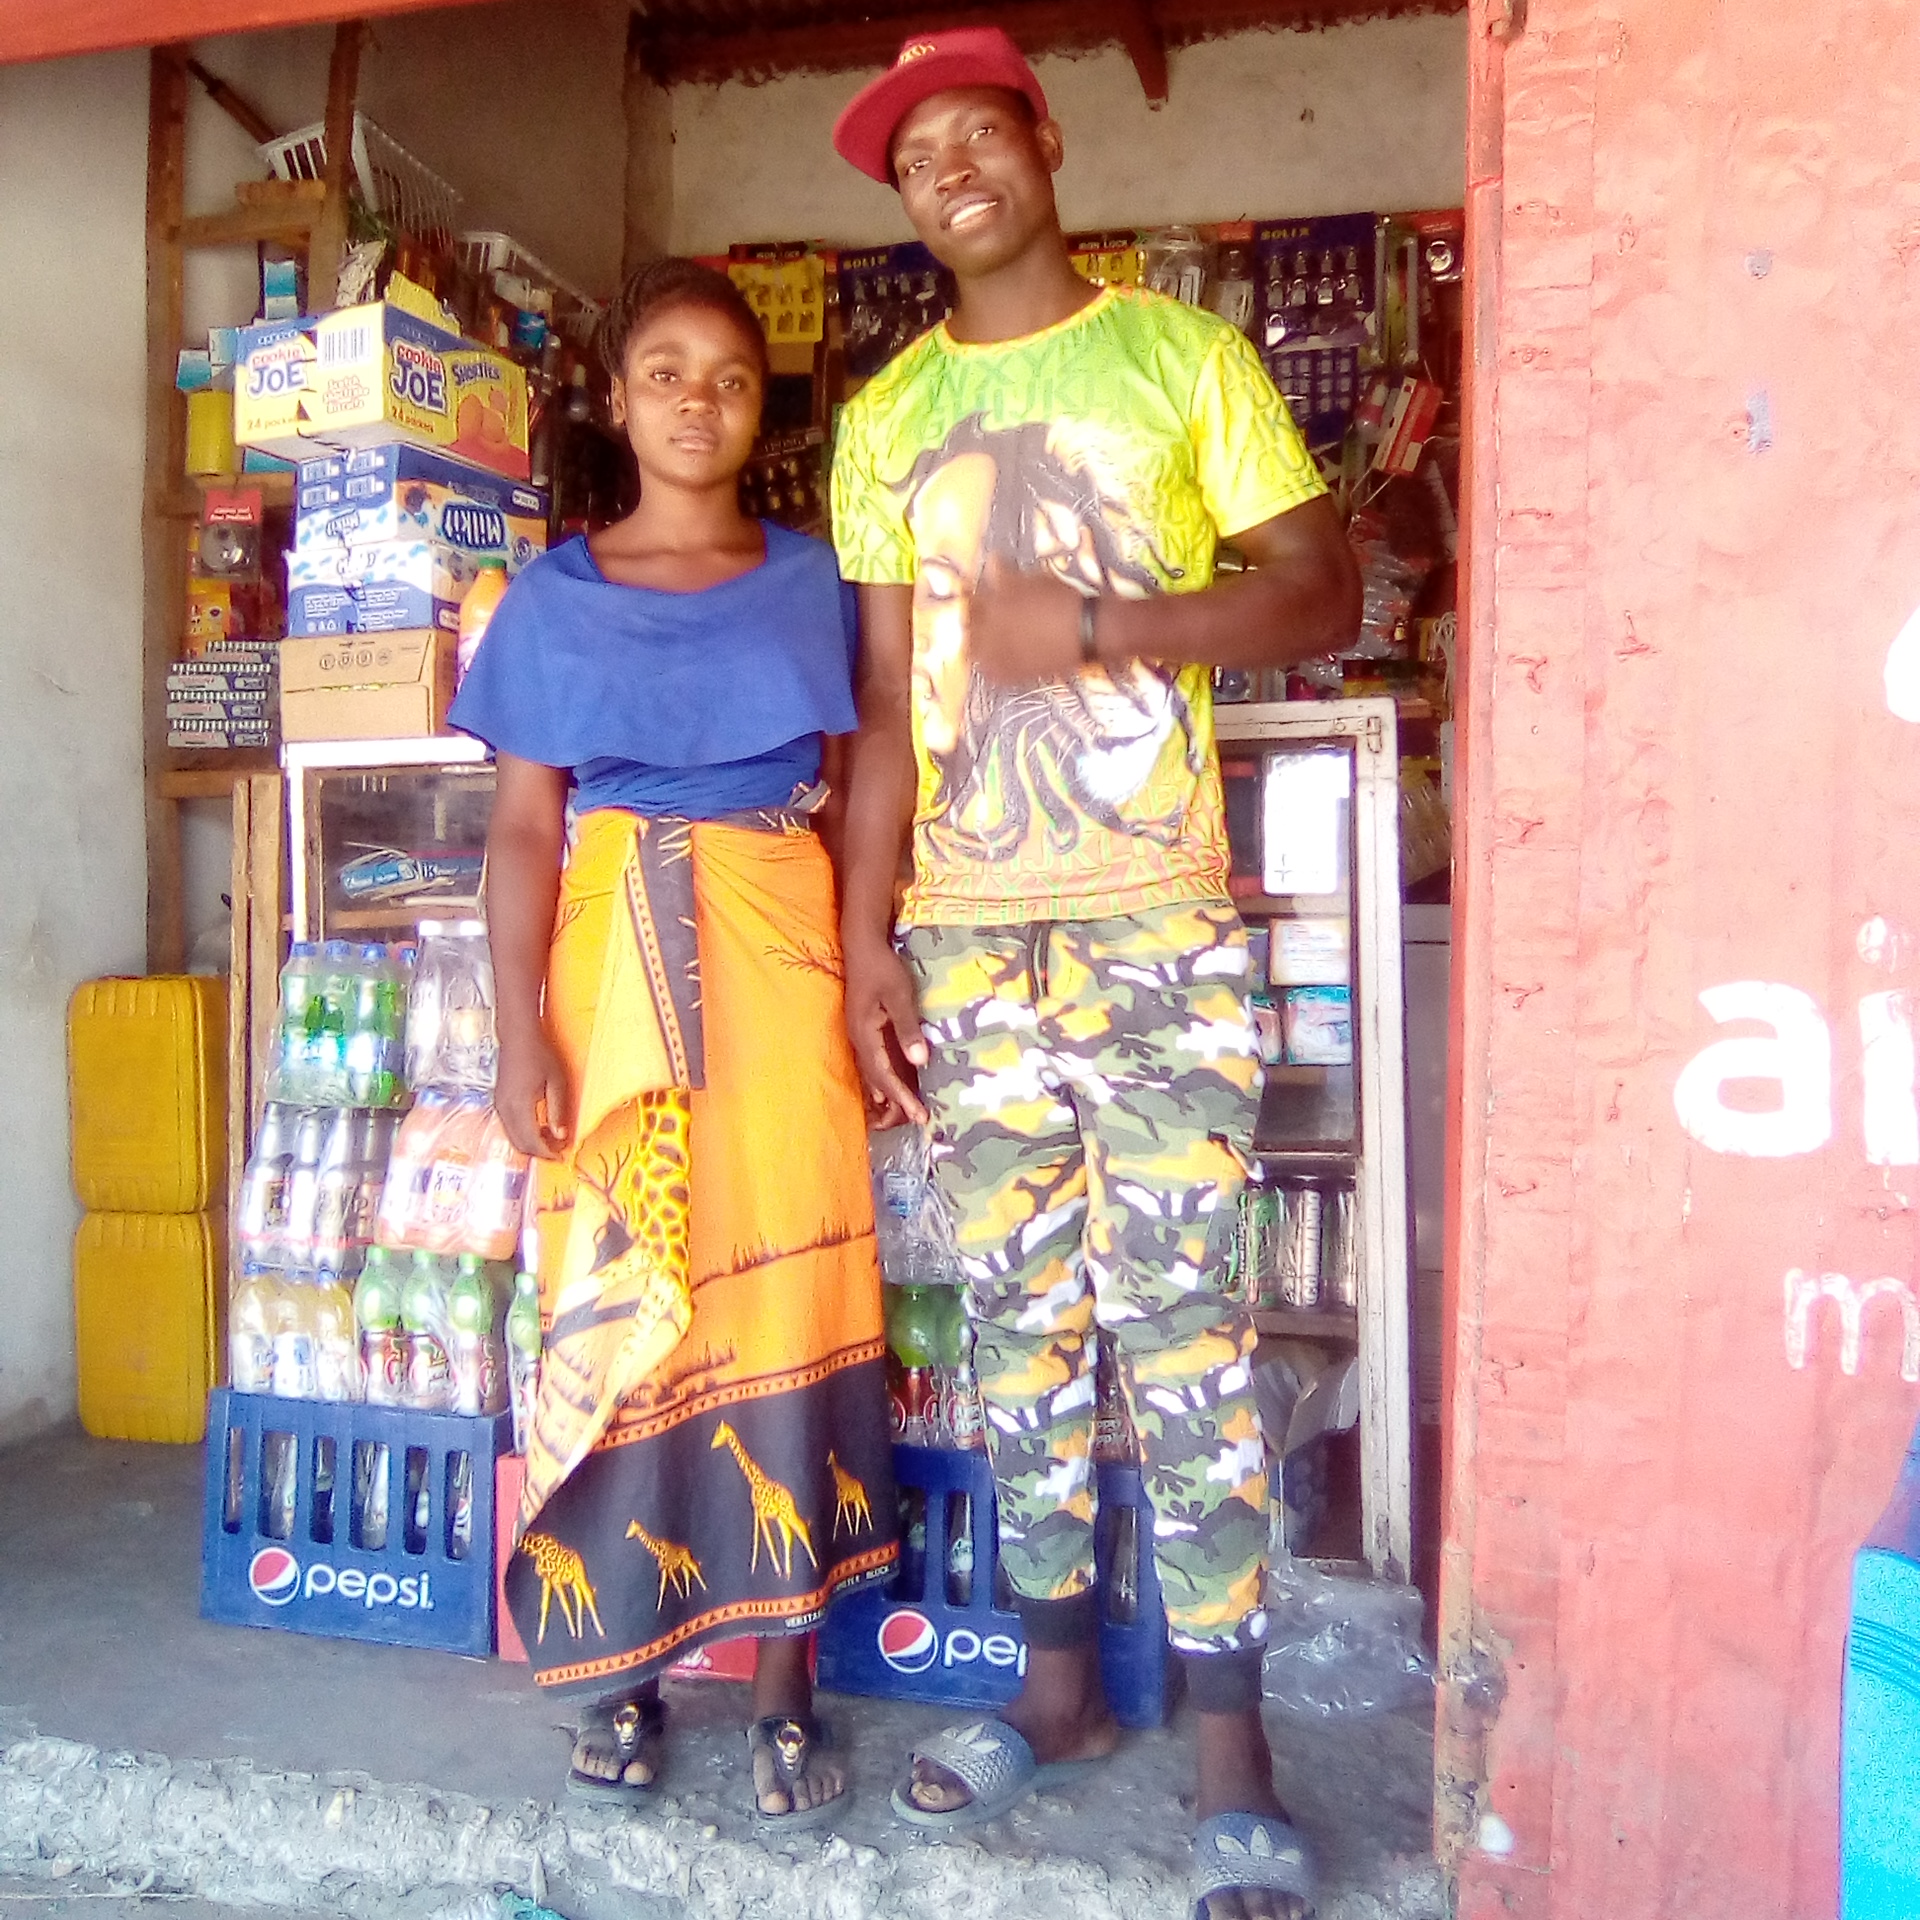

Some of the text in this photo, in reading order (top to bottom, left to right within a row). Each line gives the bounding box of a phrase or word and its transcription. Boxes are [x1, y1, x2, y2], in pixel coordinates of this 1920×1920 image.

[249, 359, 304, 395] JOE
[392, 360, 444, 409] JOE
[445, 509, 502, 546] Milkit
[304, 1563, 429, 1610] pepsi
